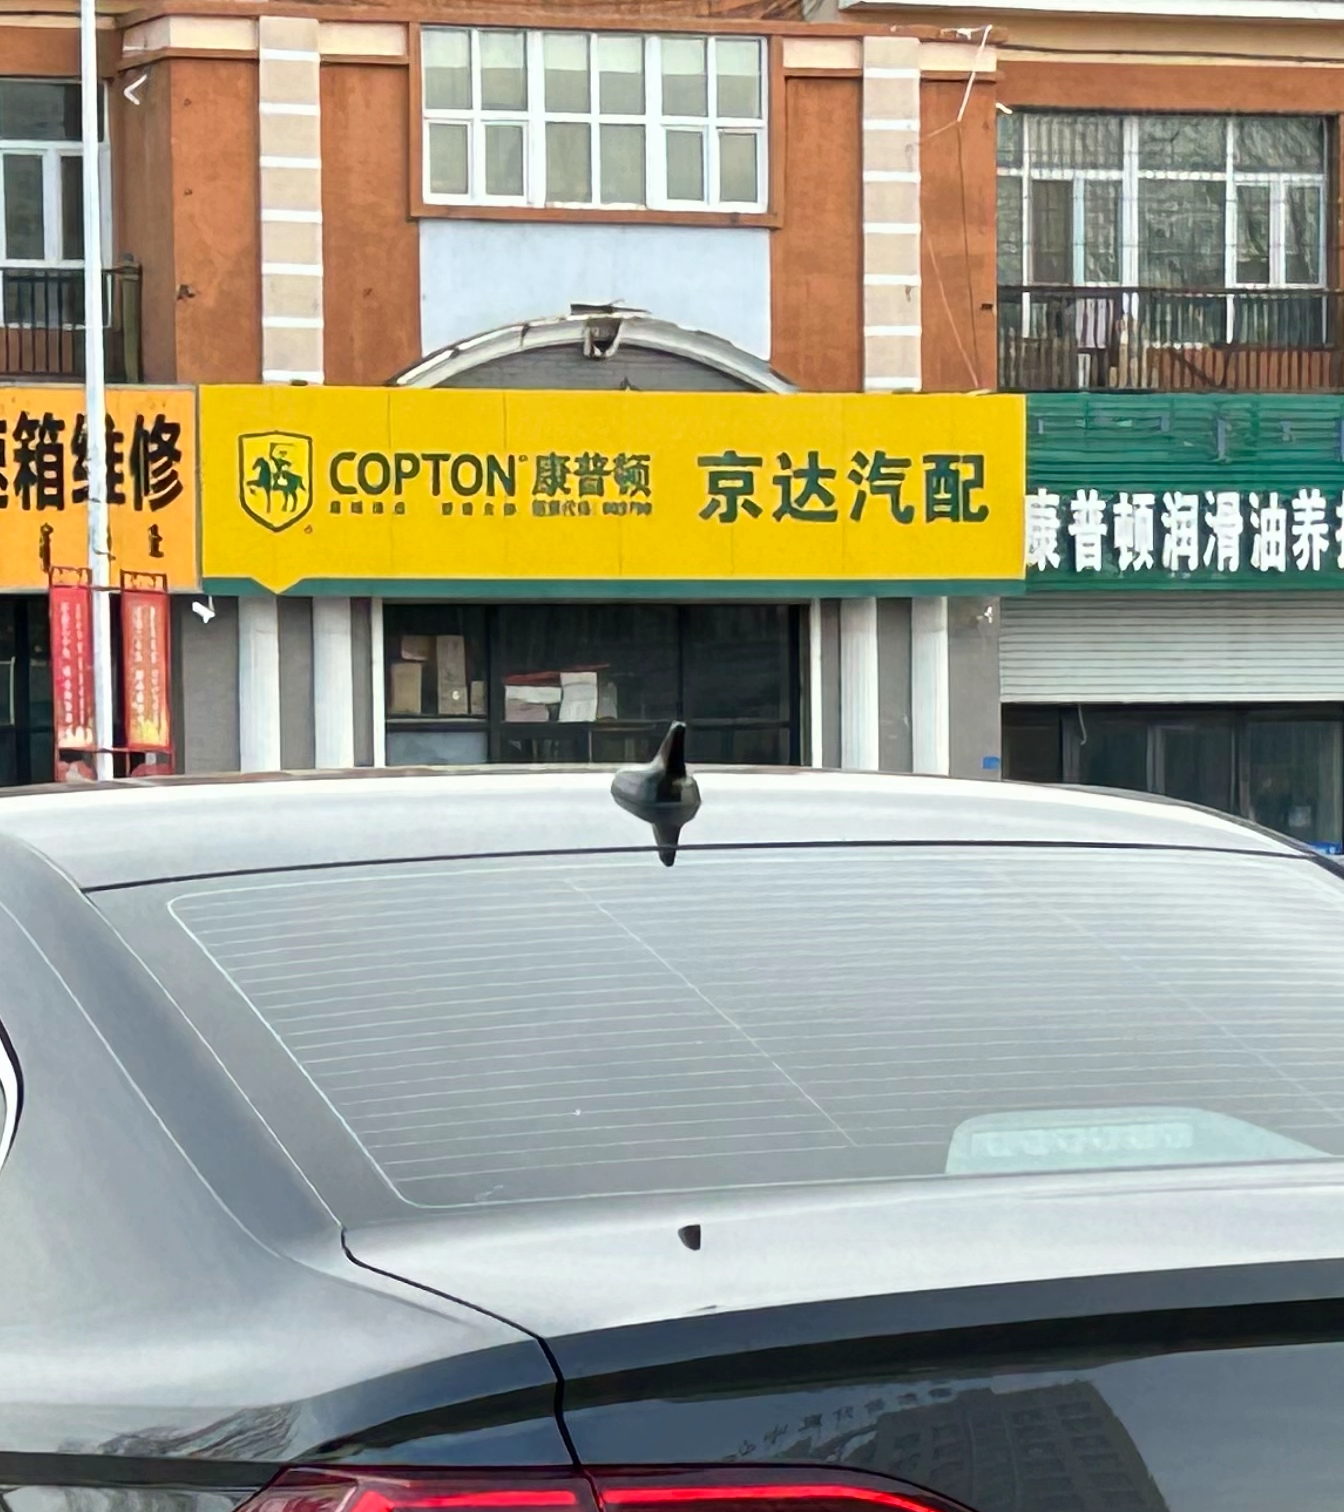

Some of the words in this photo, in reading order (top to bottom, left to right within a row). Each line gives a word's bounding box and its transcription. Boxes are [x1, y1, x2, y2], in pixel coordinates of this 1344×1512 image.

[329, 451, 516, 498] COPTON
[531, 451, 653, 498] 康普顿
[697, 450, 990, 525] 京达汽配
